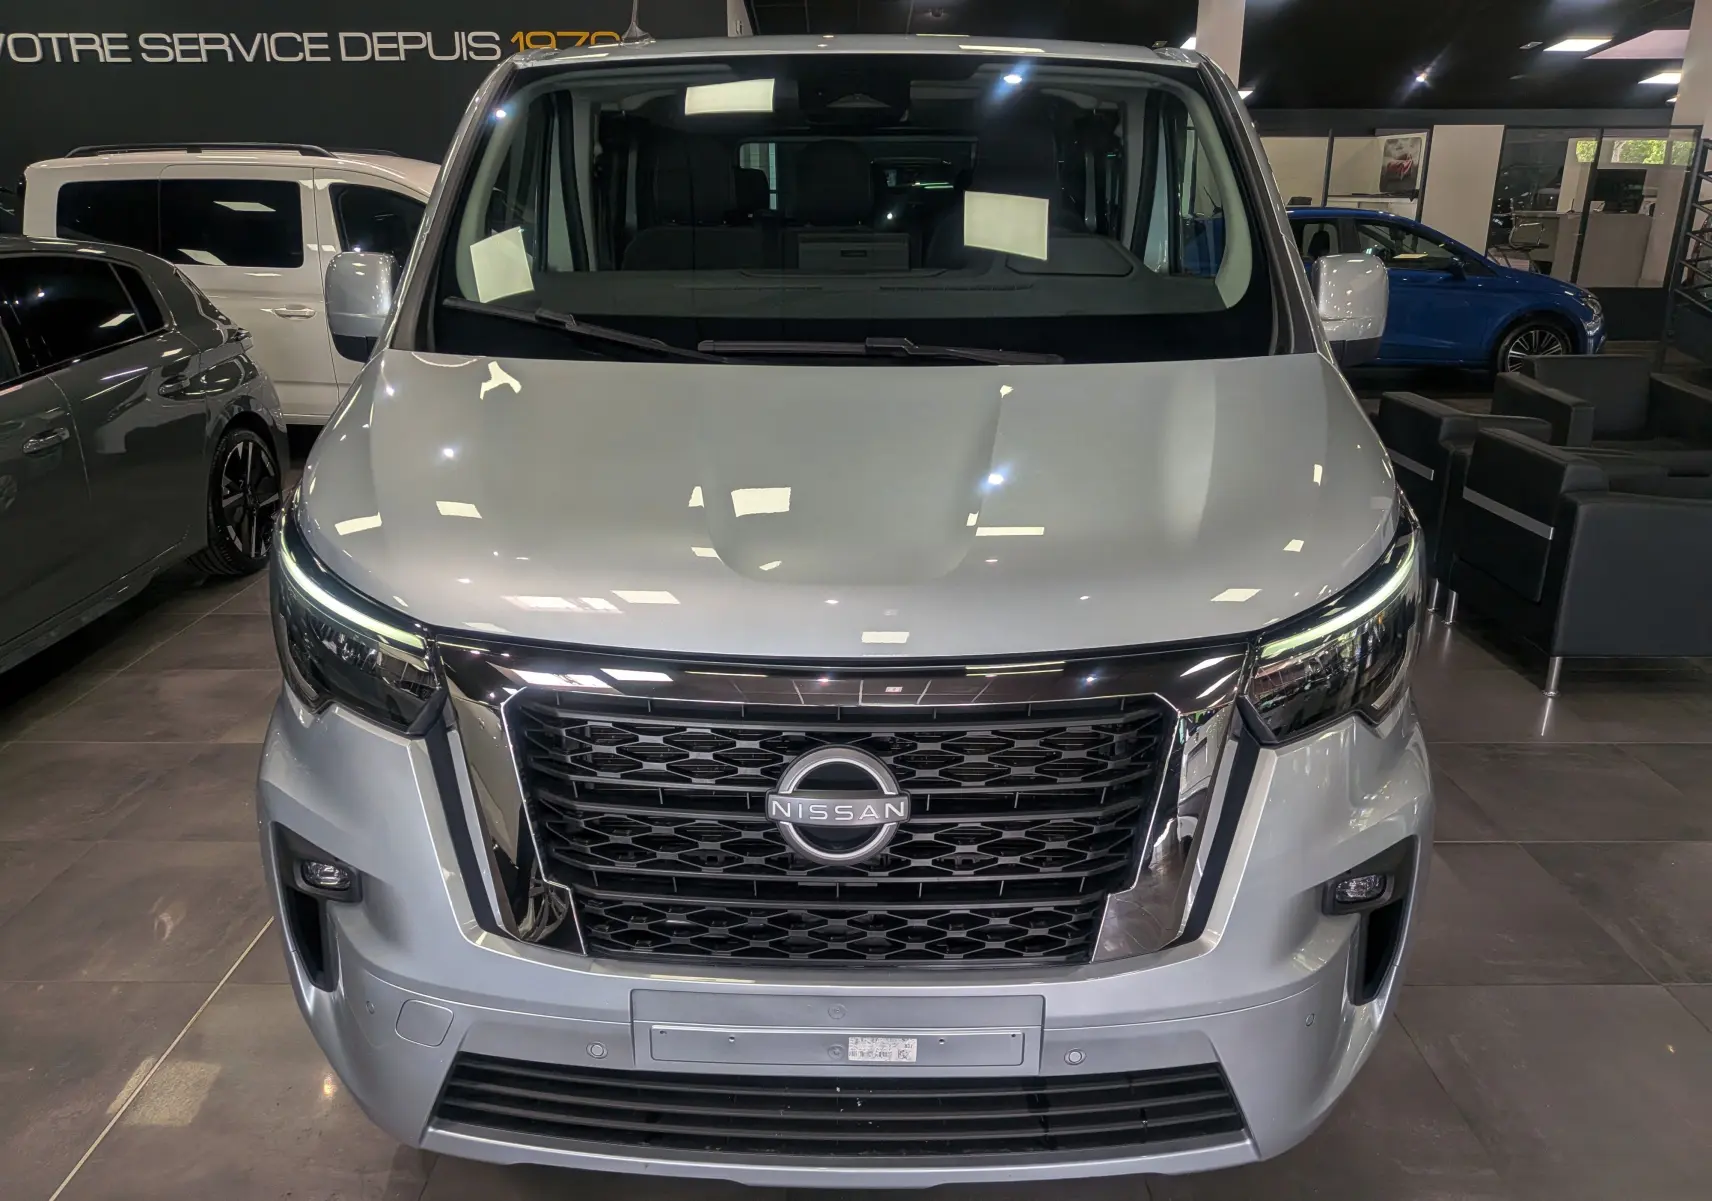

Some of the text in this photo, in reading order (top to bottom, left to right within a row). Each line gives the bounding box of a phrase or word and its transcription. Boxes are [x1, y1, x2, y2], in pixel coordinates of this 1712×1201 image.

[0, 33, 132, 63] OTRE
[138, 32, 331, 62] SERVICE
[339, 31, 501, 61] DEPUIS
[771, 800, 905, 821] NISSAN
